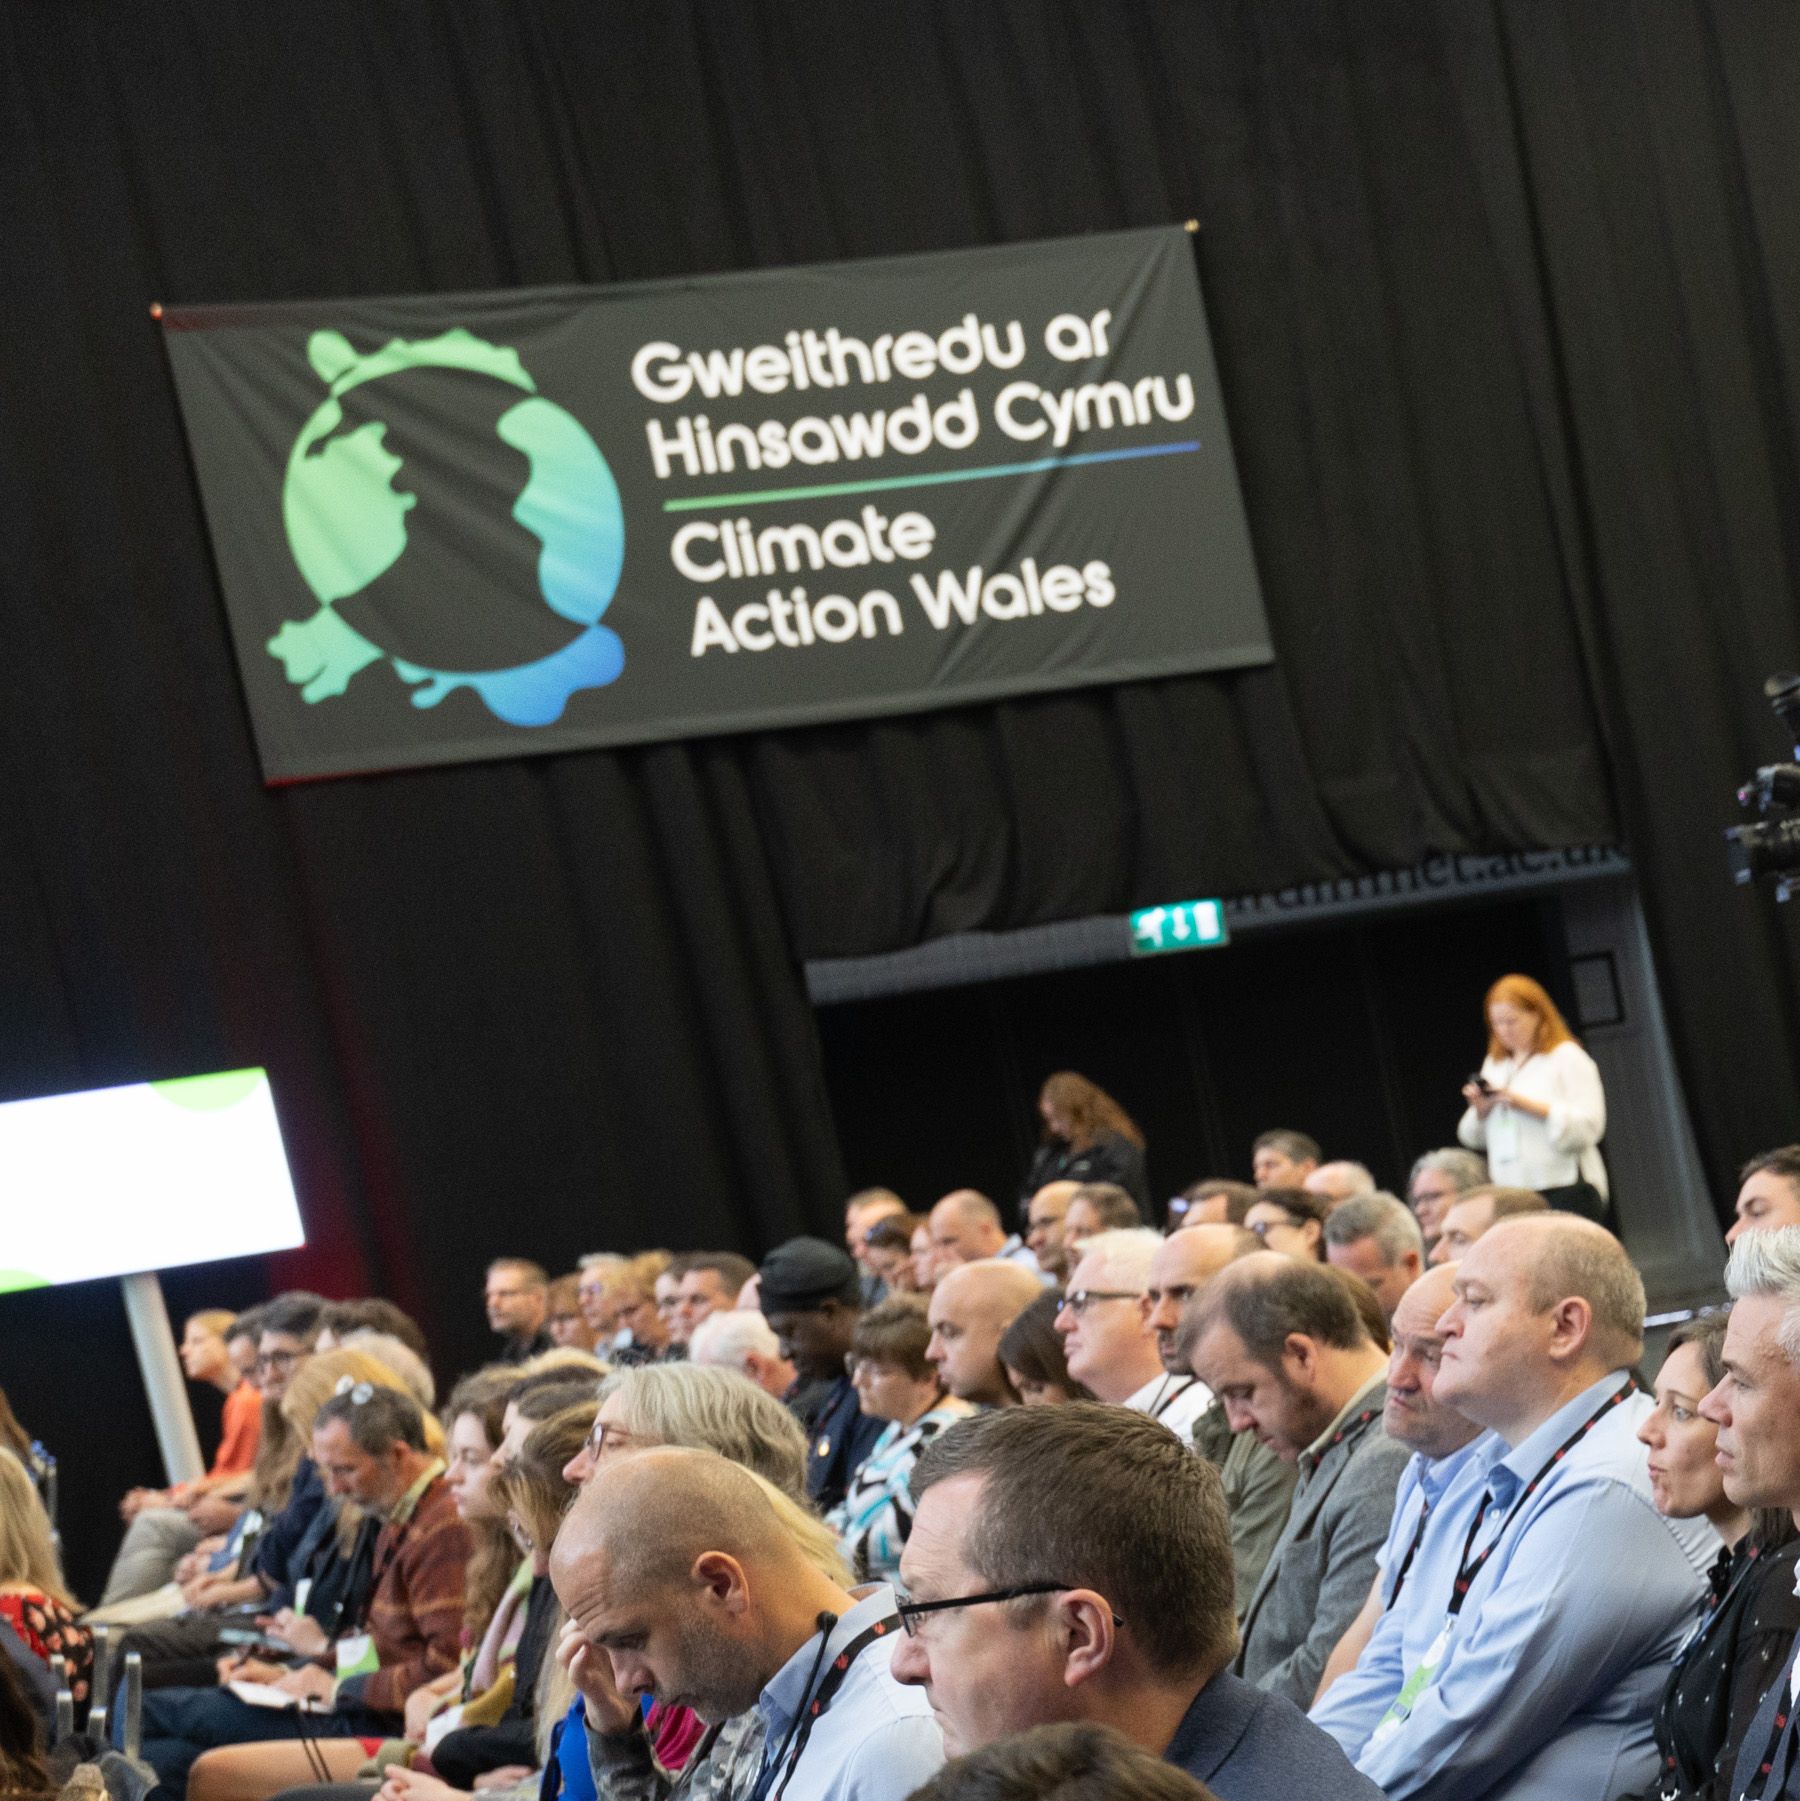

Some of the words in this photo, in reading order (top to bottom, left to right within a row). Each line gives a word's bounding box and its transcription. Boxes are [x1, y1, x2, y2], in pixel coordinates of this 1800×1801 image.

[630, 315, 1027, 405] Gweithredu
[1044, 310, 1112, 363] ar
[645, 389, 979, 478] Hinsawdd
[993, 373, 1194, 447] Cymru
[670, 508, 936, 582] Climate
[689, 582, 903, 657] Action
[910, 555, 1116, 630] Wales
